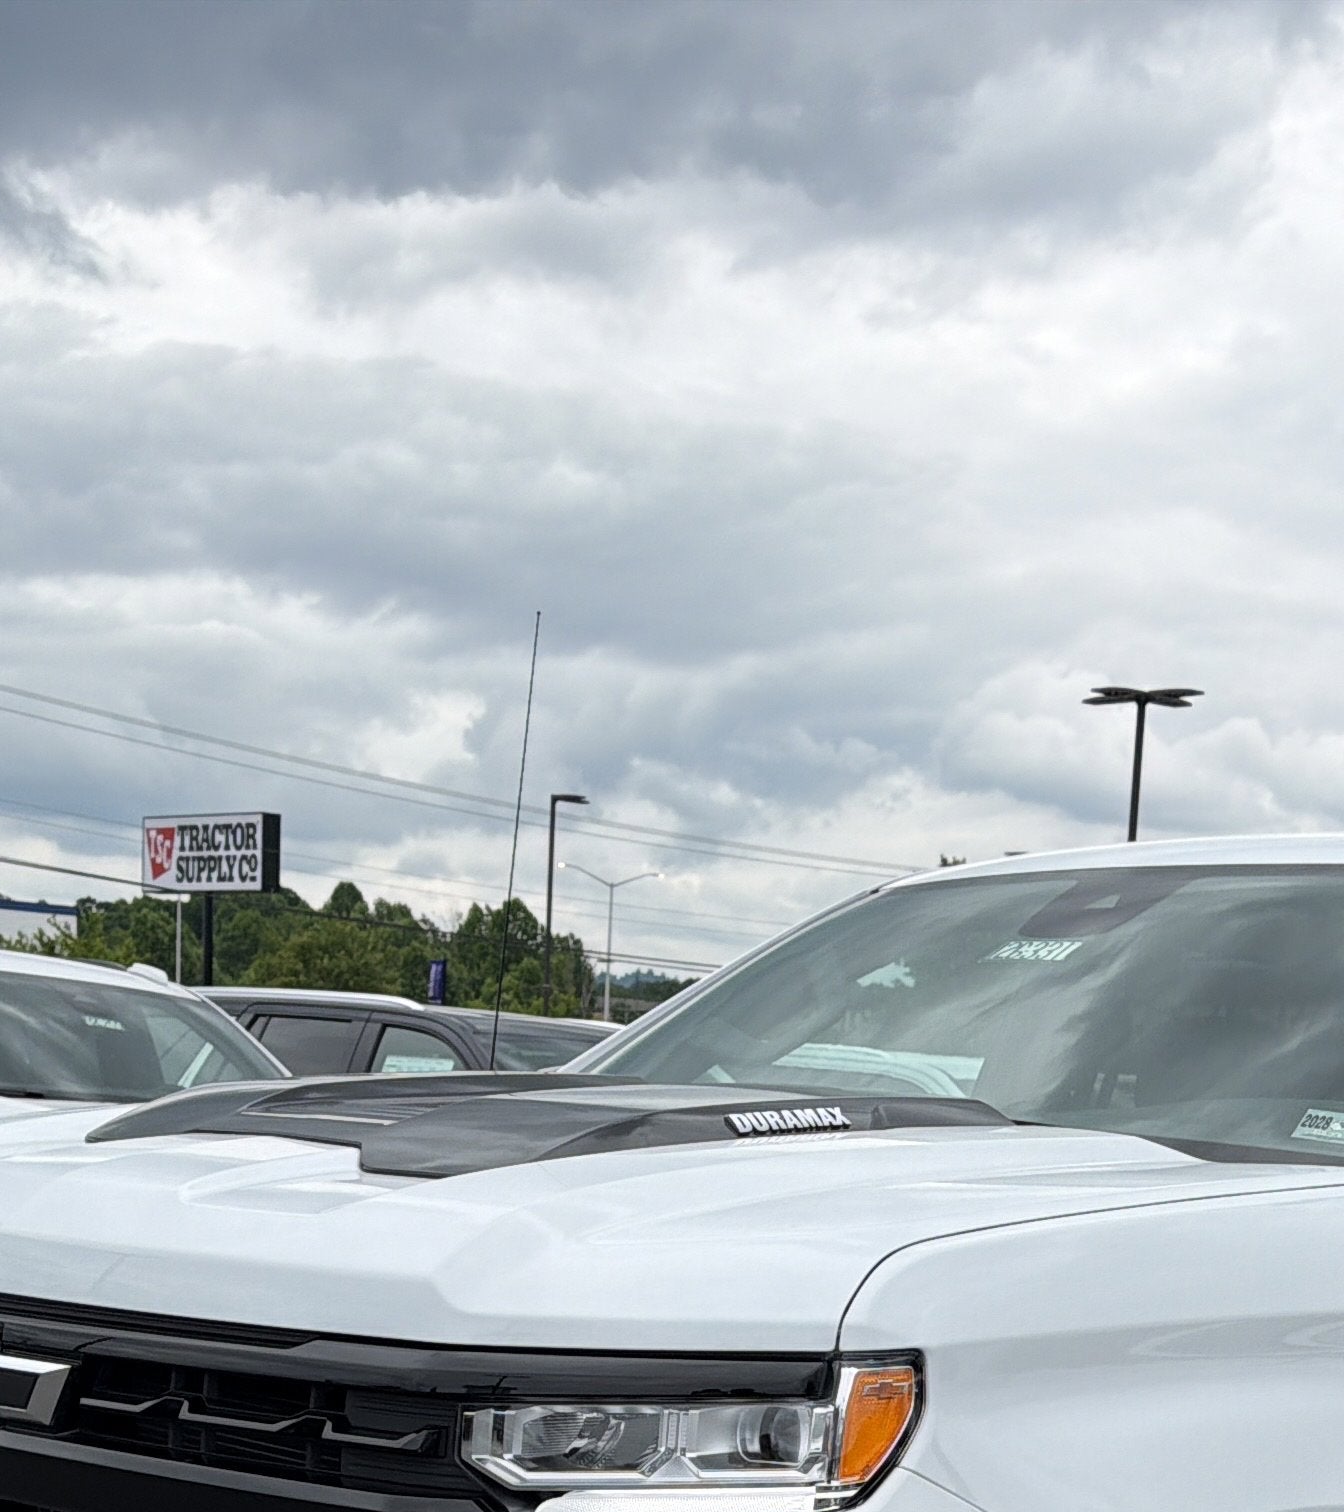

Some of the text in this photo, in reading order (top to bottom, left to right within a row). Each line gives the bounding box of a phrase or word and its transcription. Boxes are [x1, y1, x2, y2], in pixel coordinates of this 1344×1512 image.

[148, 829, 172, 870] TSC
[177, 823, 258, 852] TRACTOR
[175, 855, 237, 883] SUPPLY
[726, 1107, 853, 1135] DURAMAX
[1300, 1113, 1334, 1131] 2028
